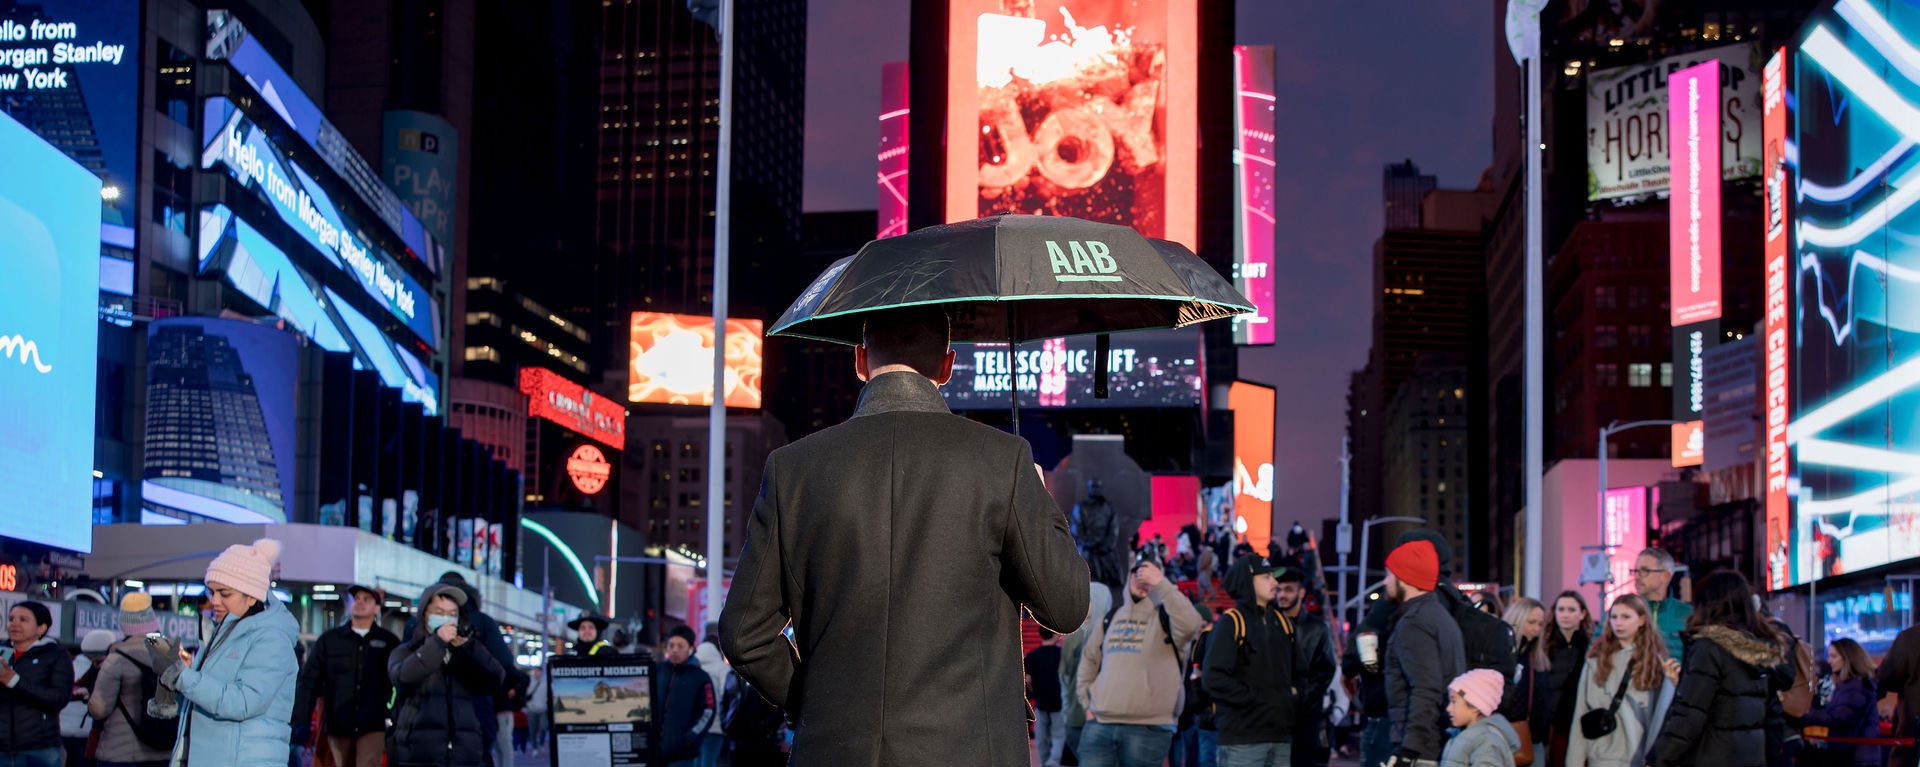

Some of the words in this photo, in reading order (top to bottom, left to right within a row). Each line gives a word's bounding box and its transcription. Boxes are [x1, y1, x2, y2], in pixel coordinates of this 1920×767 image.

[0, 19, 26, 41] llo
[30, 19, 76, 40] from
[53, 40, 124, 65] Stanley
[23, 67, 67, 89] York
[228, 124, 265, 184] Hello
[266, 162, 297, 214] from
[298, 189, 341, 252] Morgan
[1045, 240, 1118, 274] AAB
[974, 374, 1038, 392] MASCRA
[1768, 327, 1787, 495] CHOCOLATE
[551, 666, 602, 677] MIDNIGHT
[603, 665, 649, 676] MOMENT
